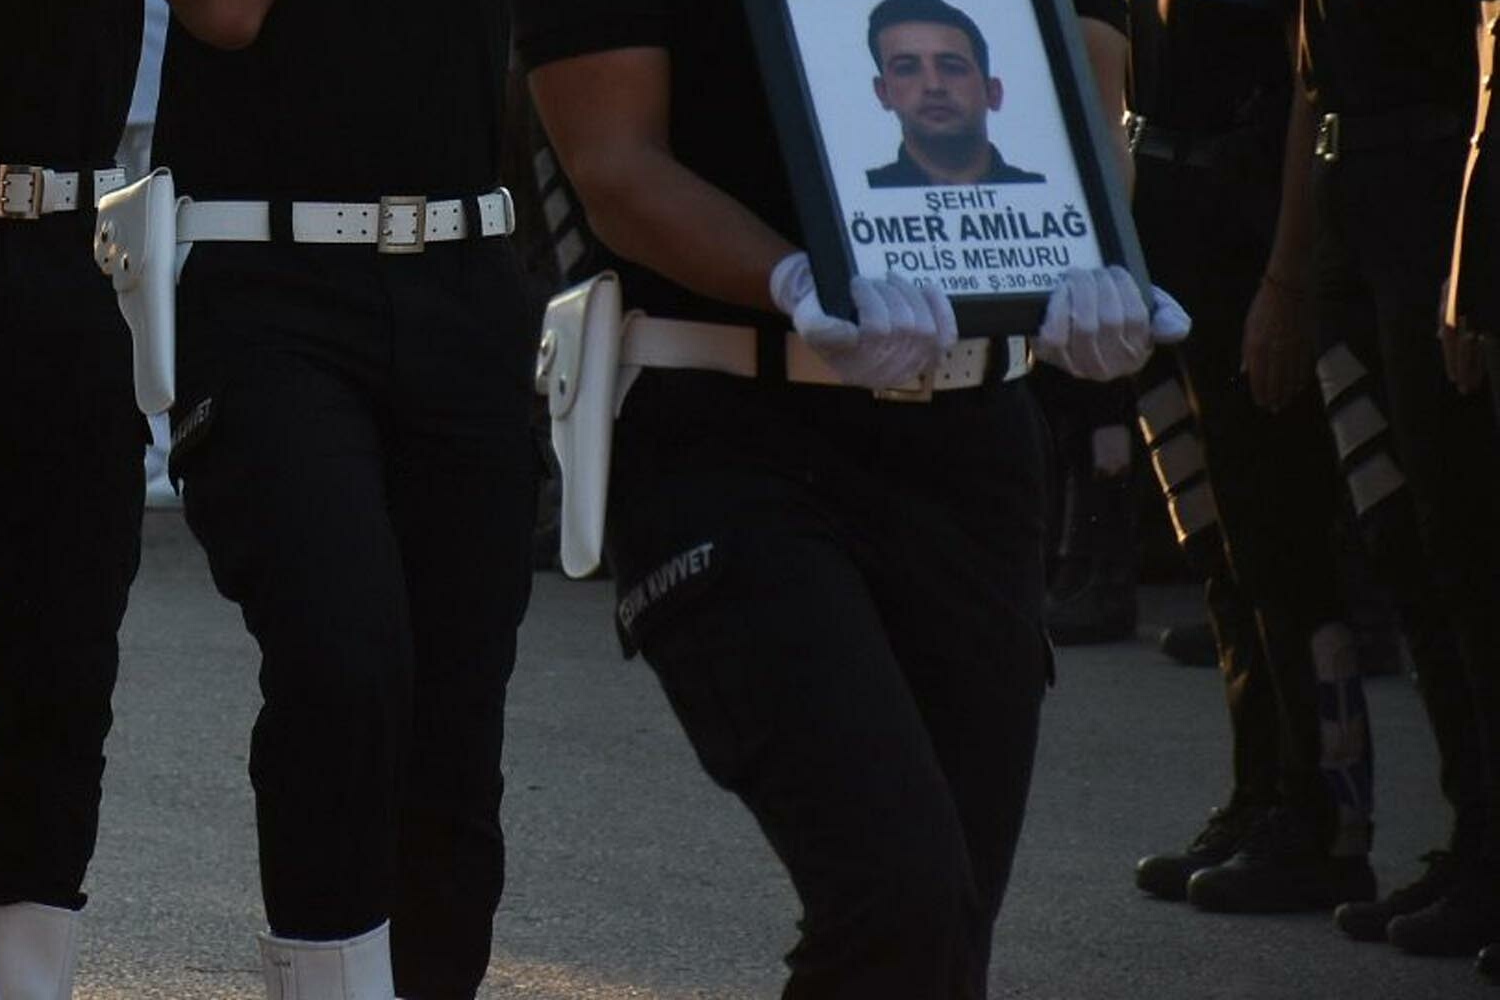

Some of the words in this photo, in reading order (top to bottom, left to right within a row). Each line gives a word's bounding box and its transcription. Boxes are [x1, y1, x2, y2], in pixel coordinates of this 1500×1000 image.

[925, 188, 998, 213] ŞEHİT
[851, 212, 949, 245] ÖMER
[960, 204, 1088, 241] AMİLAĞ
[885, 246, 957, 272] POLİS
[964, 245, 1070, 271] MEMURU
